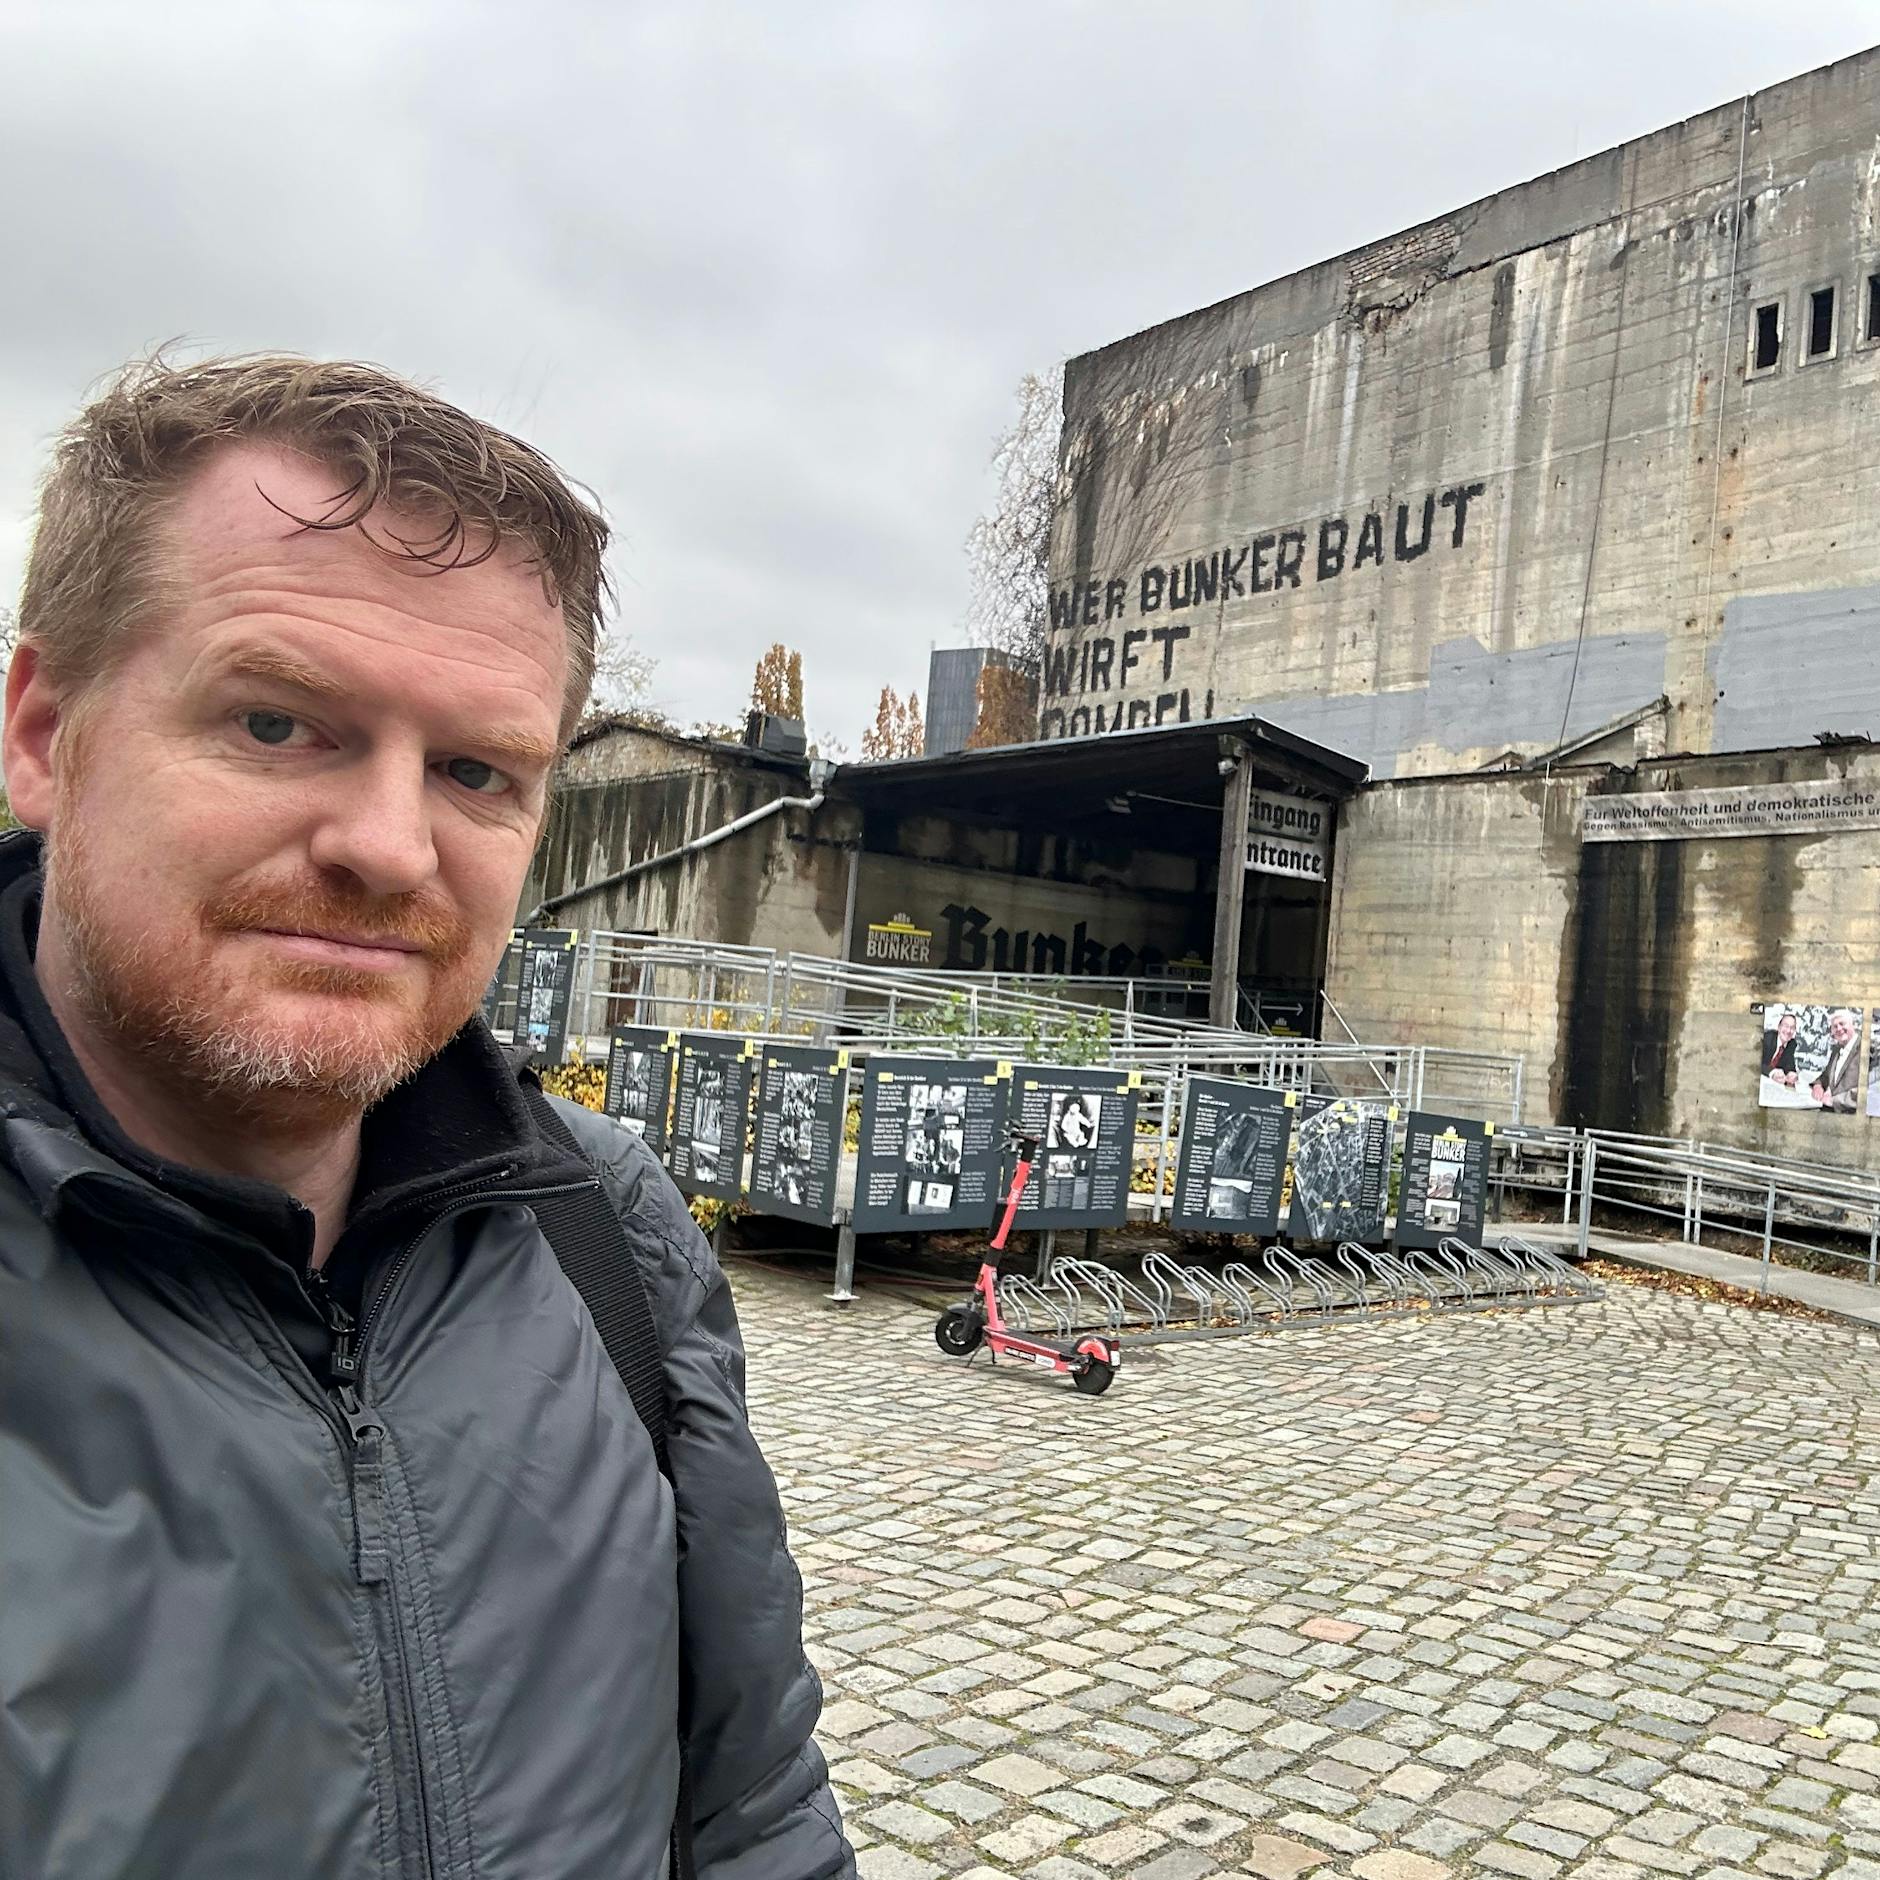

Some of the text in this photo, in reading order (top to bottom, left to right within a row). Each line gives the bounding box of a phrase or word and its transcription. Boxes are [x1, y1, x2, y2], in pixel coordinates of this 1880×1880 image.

[1049, 483, 1486, 630] WER BUNKER BAUT
[1042, 626, 1190, 697] WIRFT
[1249, 793, 1321, 836] ingang
[1584, 821, 1617, 832] Gegen
[1775, 808, 1864, 822] Nationalismus
[1611, 803, 1708, 820] Weltoffenheit
[1714, 799, 1741, 814] und
[1747, 792, 1875, 812] demokratische
[1247, 841, 1322, 874] ntrance
[866, 940, 931, 962] BUNKER
[1430, 1145, 1466, 1163] BUNKER
